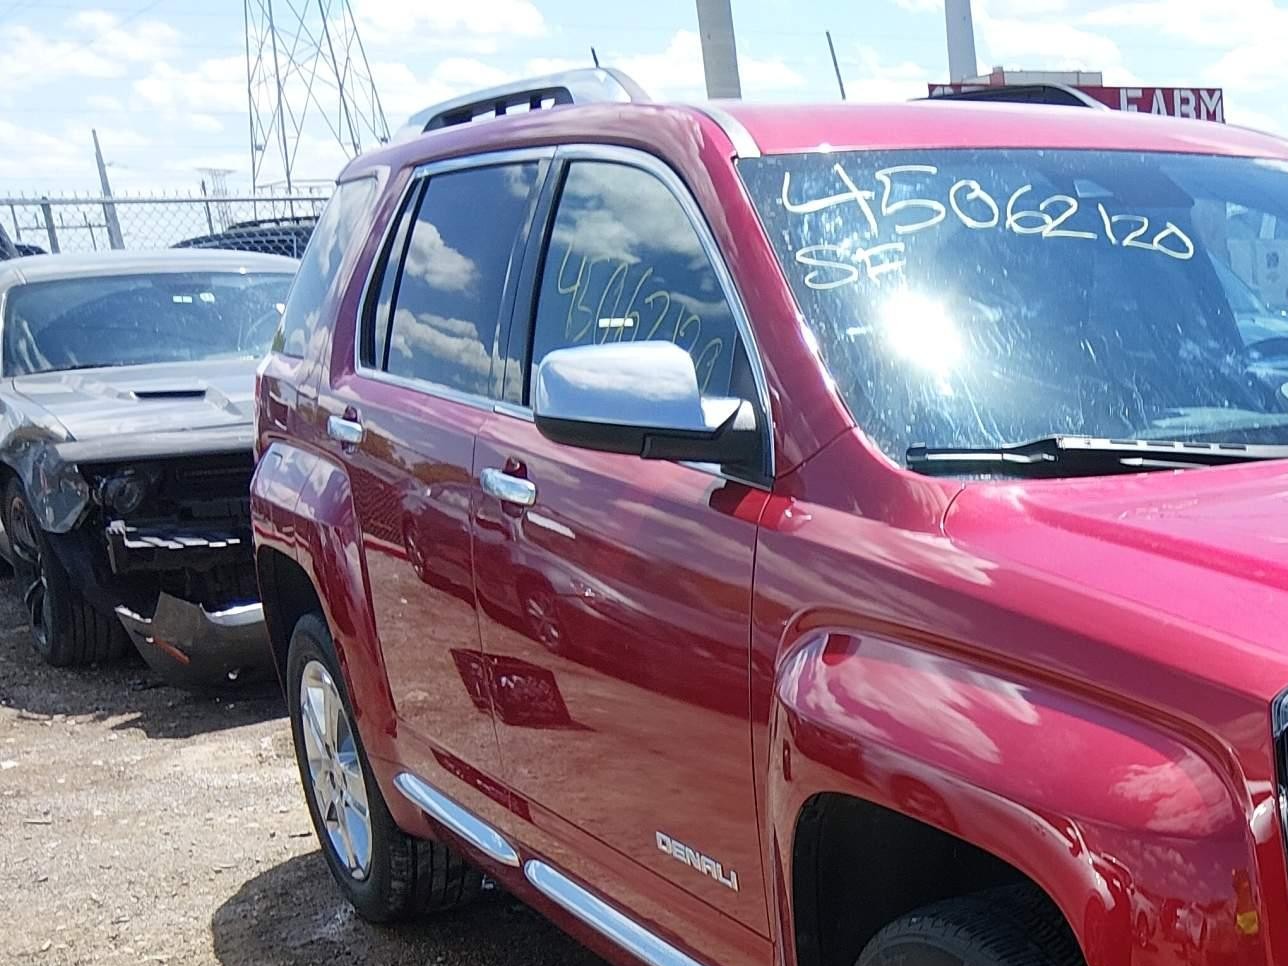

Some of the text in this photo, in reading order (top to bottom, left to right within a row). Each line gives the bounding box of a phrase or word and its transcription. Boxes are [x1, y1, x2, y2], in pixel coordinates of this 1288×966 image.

[1120, 88, 1222, 122] FARM
[782, 163, 1195, 259] 45062120
[655, 831, 739, 892] DENALI
